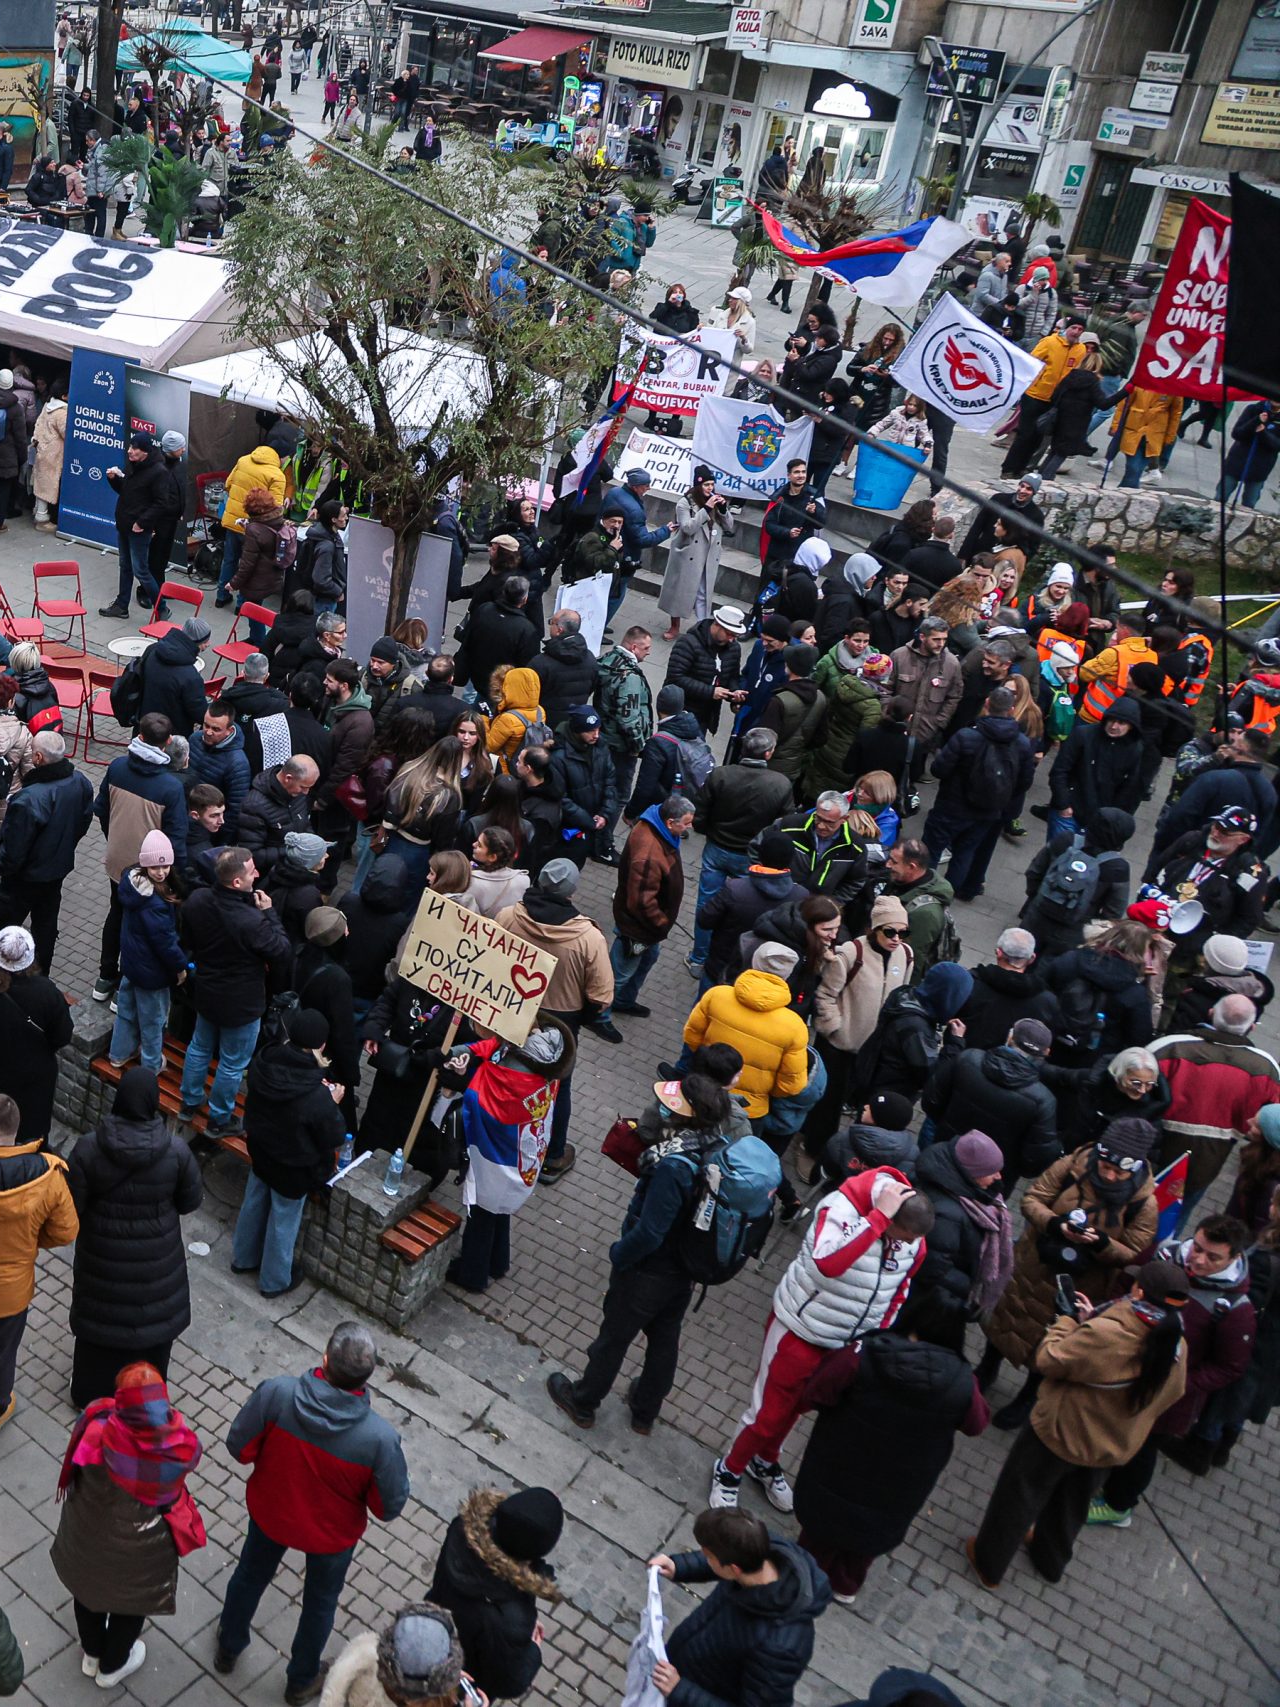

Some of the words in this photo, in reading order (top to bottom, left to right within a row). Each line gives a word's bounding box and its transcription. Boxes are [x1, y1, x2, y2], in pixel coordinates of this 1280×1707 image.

[736, 10, 759, 21] FOTO
[736, 22, 761, 33] KULA
[860, 25, 888, 38] SAVA
[613, 41, 637, 61] FOTO
[638, 45, 664, 67] KULA
[666, 49, 690, 71] RIZO
[1189, 226, 1232, 279] N
[1172, 280, 1228, 310] SLOB
[1166, 308, 1226, 335] UNIVE
[628, 388, 700, 410] RAGUJEVAC
[929, 364, 988, 409] КРАГУЈЕВАЦ
[74, 418, 116, 437] ODMORI,
[75, 405, 105, 421] UGRIJ
[107, 412, 123, 425] SE,
[73, 430, 125, 450] PROZBORI.
[427, 897, 445, 919] И
[457, 909, 538, 969] ЧАЧАНИ
[456, 938, 487, 963] СУ
[415, 940, 525, 1015] ПОХИТАЛИ
[406, 962, 423, 979] У
[427, 973, 502, 1027] СВИЈЕТ
